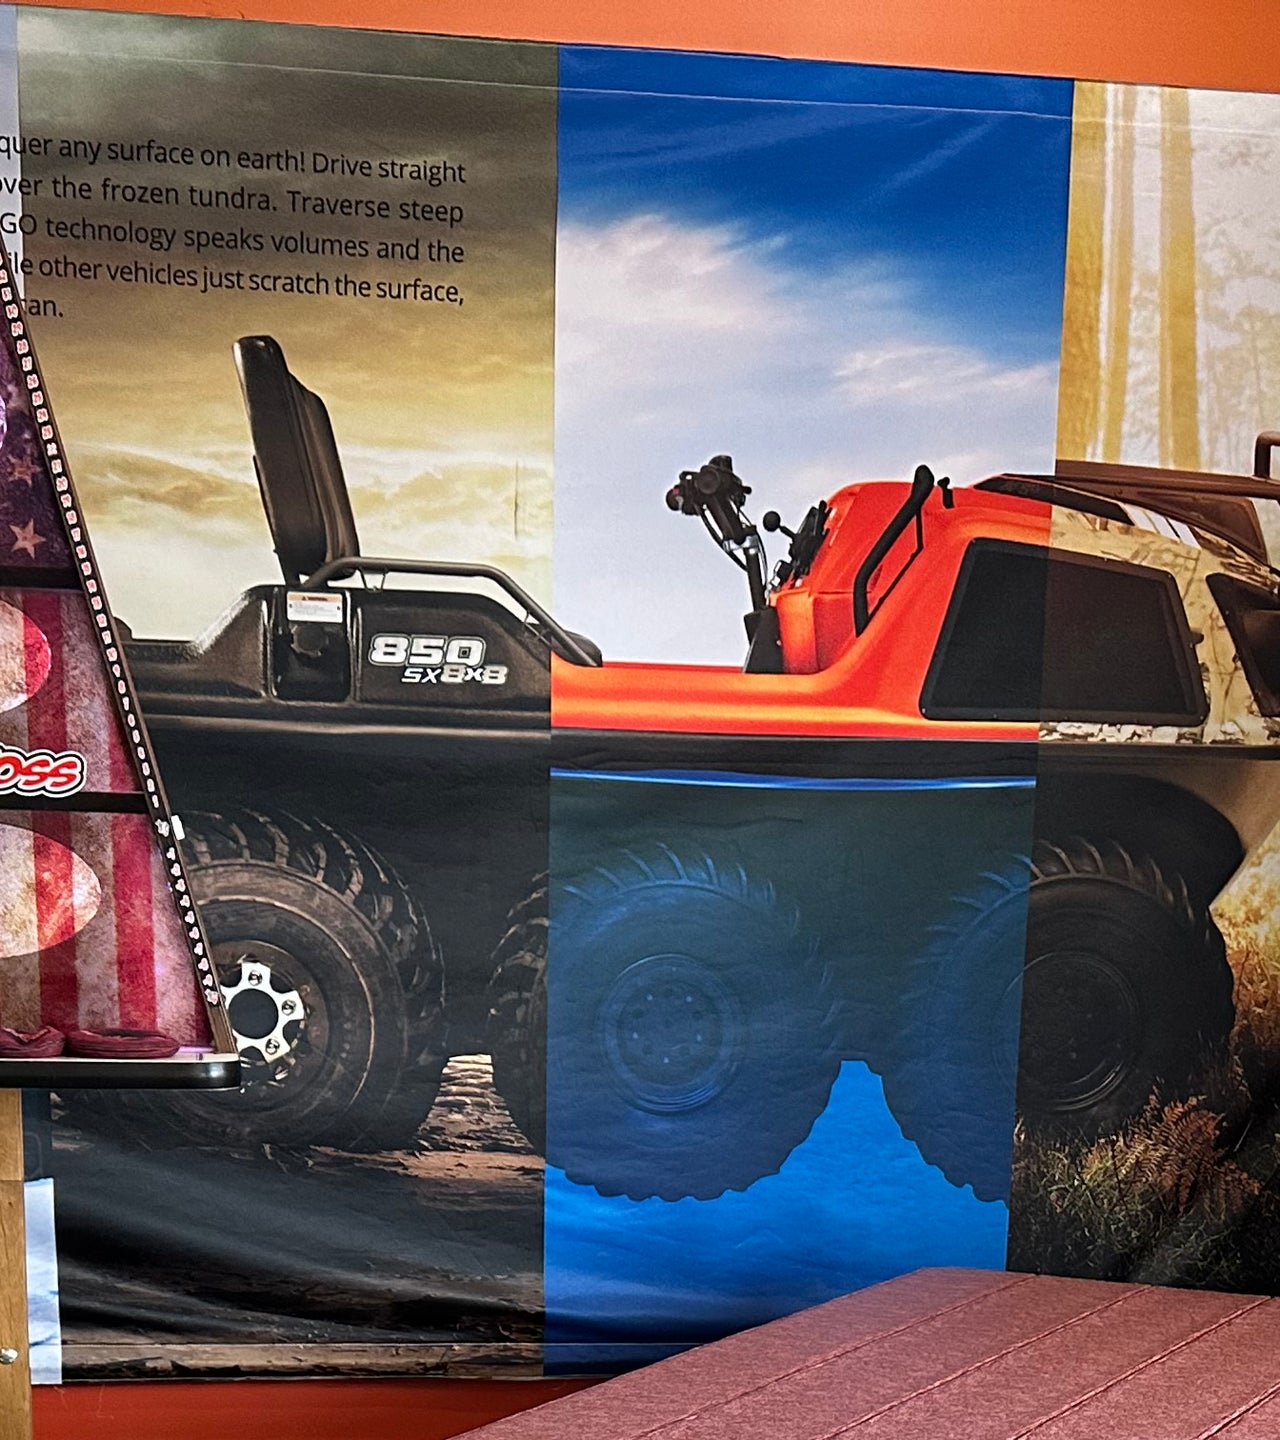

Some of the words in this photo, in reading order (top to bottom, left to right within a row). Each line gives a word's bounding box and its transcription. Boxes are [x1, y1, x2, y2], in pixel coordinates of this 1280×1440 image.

[59, 142, 101, 166] any
[107, 138, 193, 165] surface
[200, 148, 230, 168] on
[236, 148, 304, 174] earth!
[313, 151, 372, 178] Drive
[379, 156, 467, 189] straight
[51, 174, 91, 200] the
[101, 177, 179, 205] frozen
[188, 185, 276, 212] tundra.
[286, 189, 390, 219] Traverse
[399, 199, 463, 229] steep
[45, 216, 176, 252] technology
[183, 227, 263, 254] speaks
[270, 230, 368, 258] volumes
[376, 237, 419, 264] and
[427, 238, 464, 264] the
[39, 256, 102, 282] other
[106, 260, 197, 287] vehicles
[200, 265, 244, 293] just
[248, 272, 328, 295] scratch
[334, 273, 371, 298] the
[376, 277, 463, 306] surface,
[371, 635, 484, 666] 850
